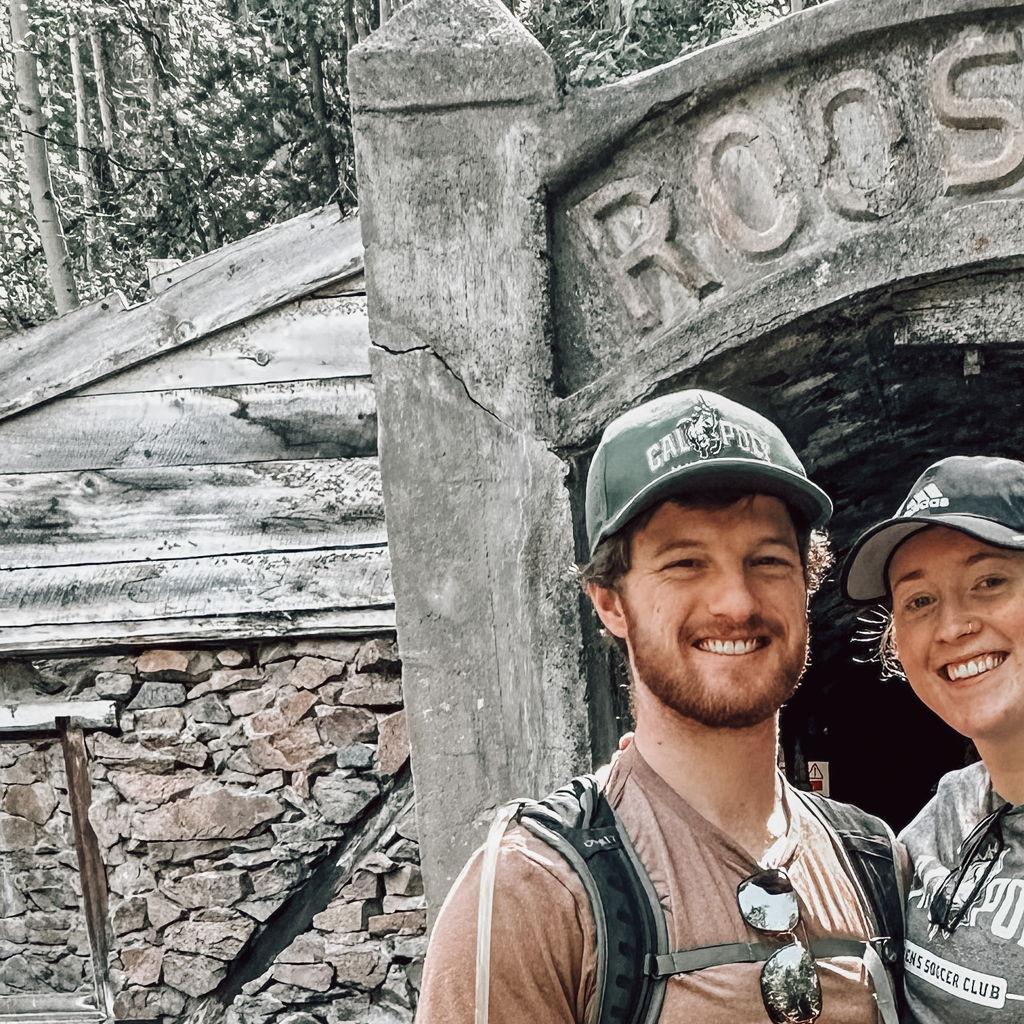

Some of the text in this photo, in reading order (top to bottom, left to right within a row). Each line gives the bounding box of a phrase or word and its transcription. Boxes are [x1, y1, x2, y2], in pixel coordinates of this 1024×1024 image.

[646, 419, 771, 473] CAL POLY
[905, 949, 1001, 1000] ENS SOCCER CLUB
